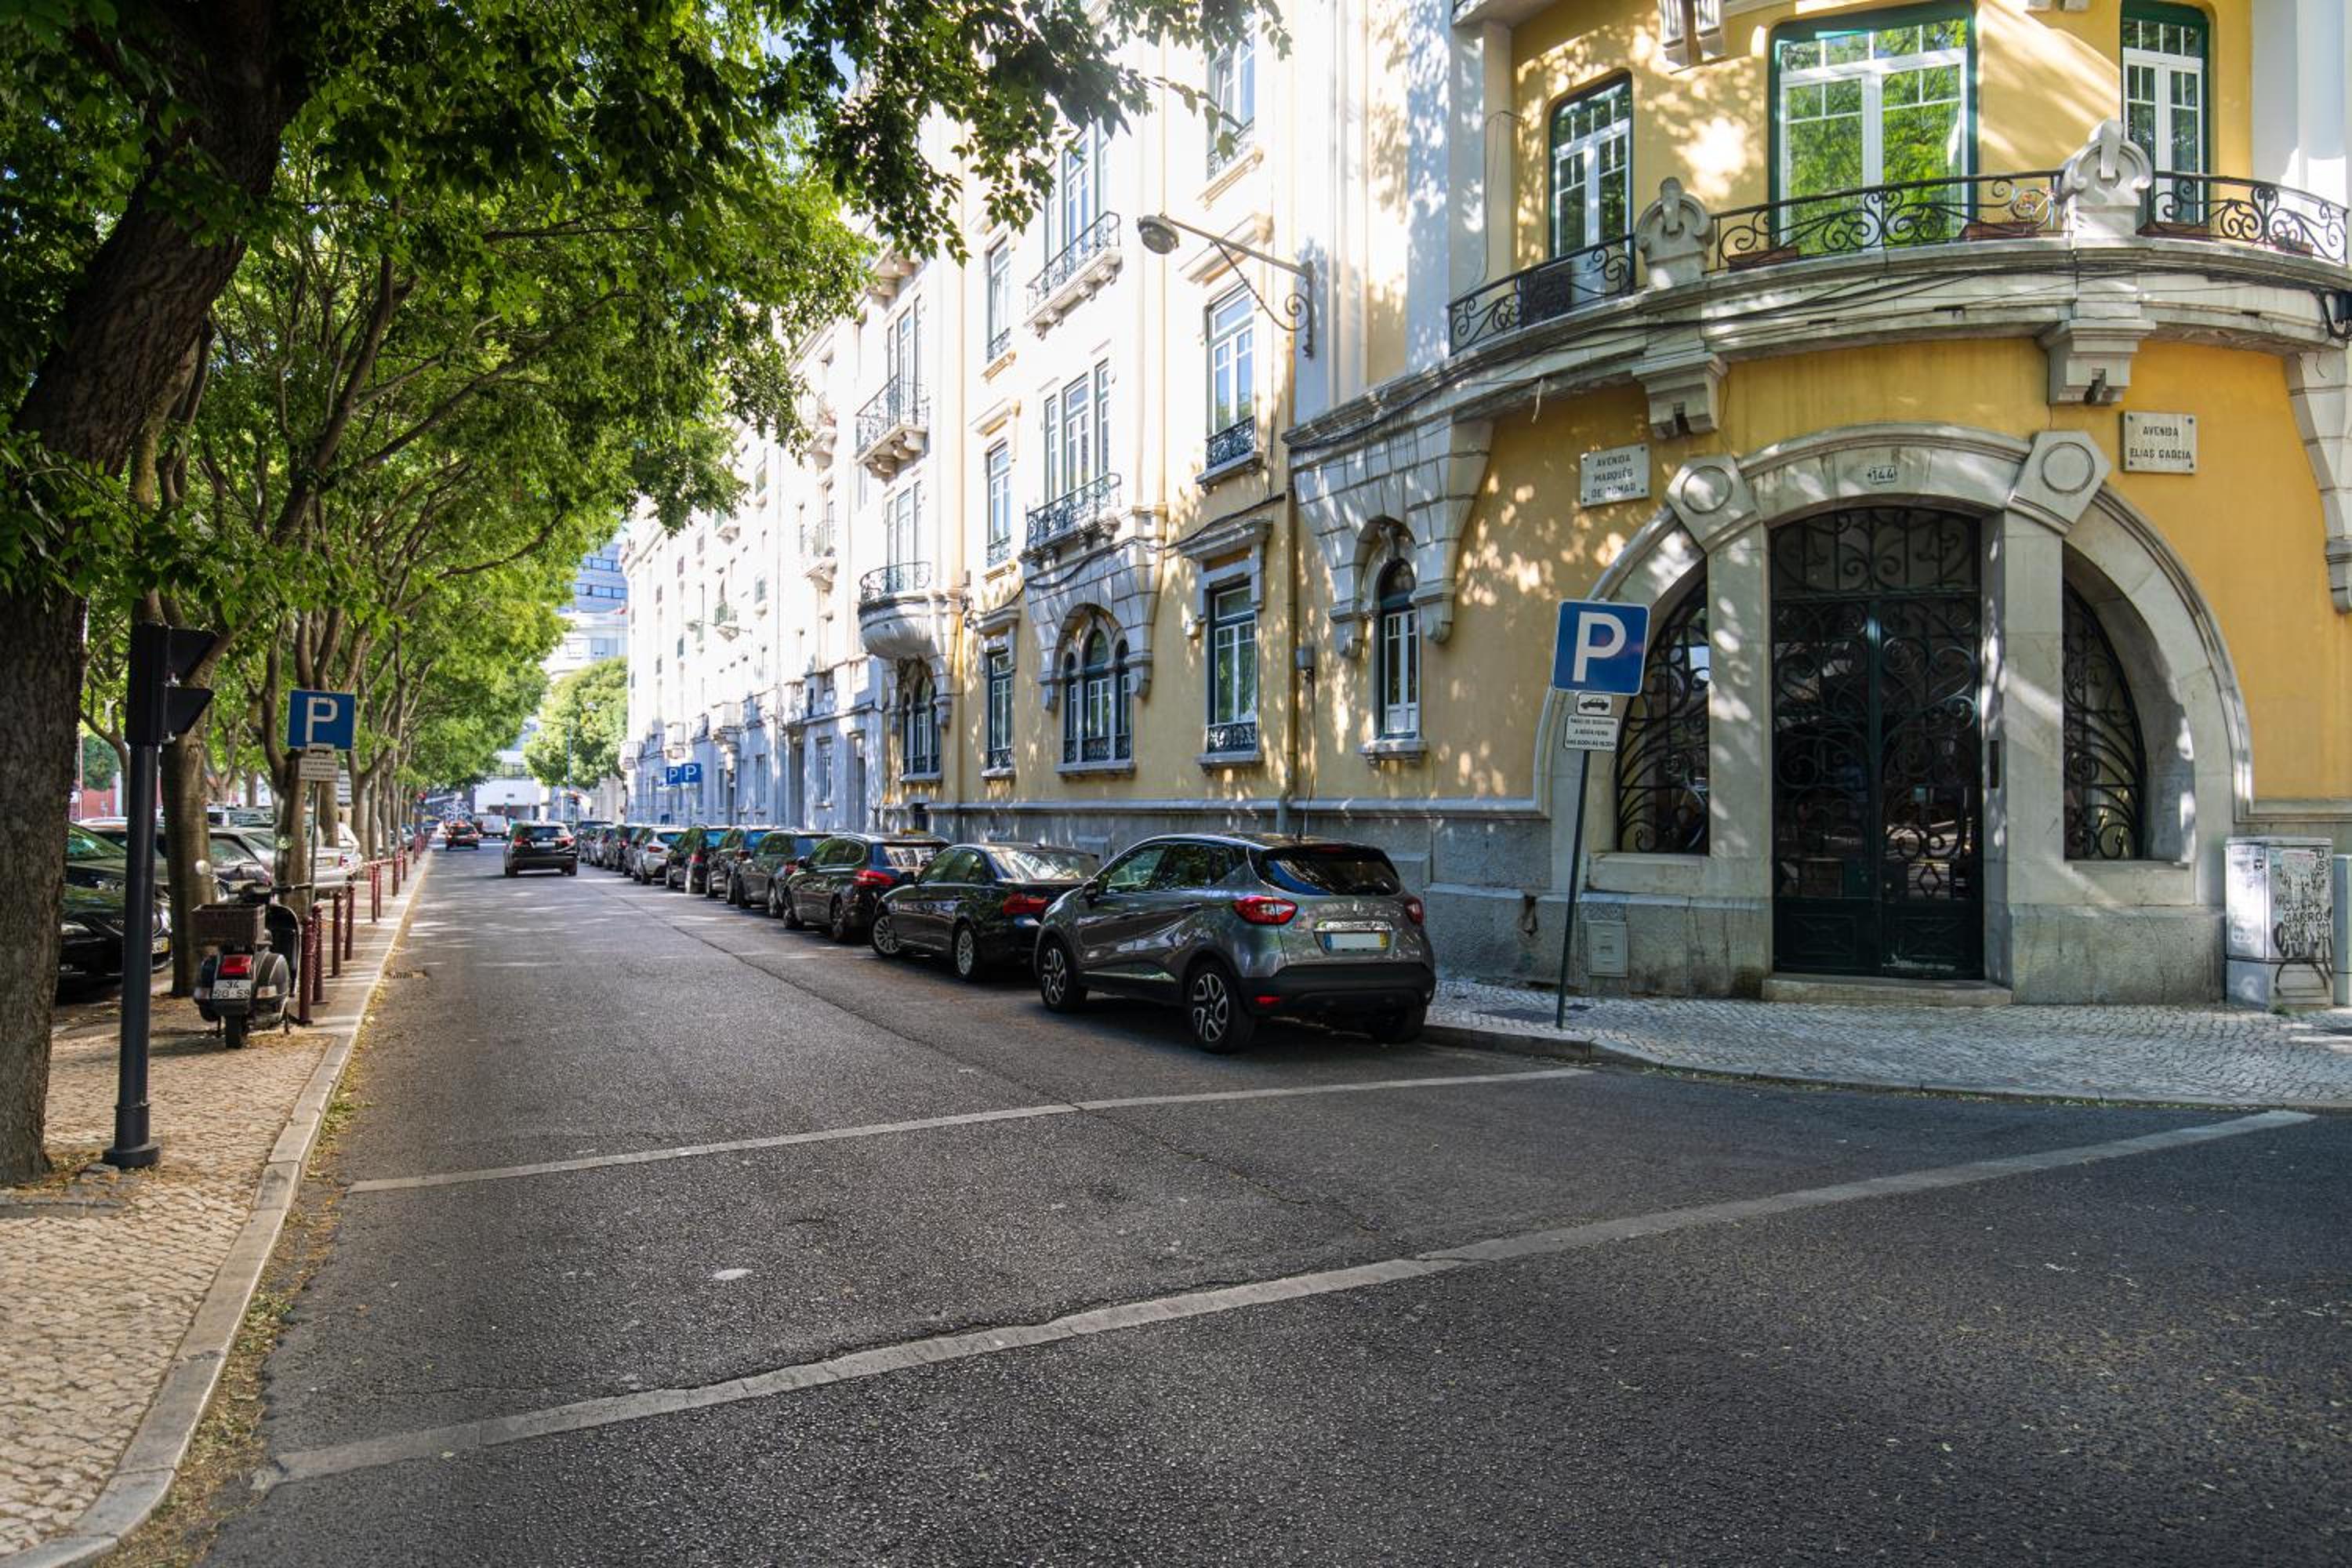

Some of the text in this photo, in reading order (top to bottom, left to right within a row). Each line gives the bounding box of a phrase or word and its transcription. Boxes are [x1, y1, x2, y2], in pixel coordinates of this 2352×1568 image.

[2143, 426, 2179, 437] AVENIDA
[1596, 454, 1632, 467] AVENIDA
[2129, 448, 2191, 460] ELIAS GARCIA
[1591, 488, 1601, 499] DE
[1573, 612, 1627, 683] P
[305, 696, 338, 742] P
[669, 768, 678, 782] P
[684, 764, 697, 781] P
